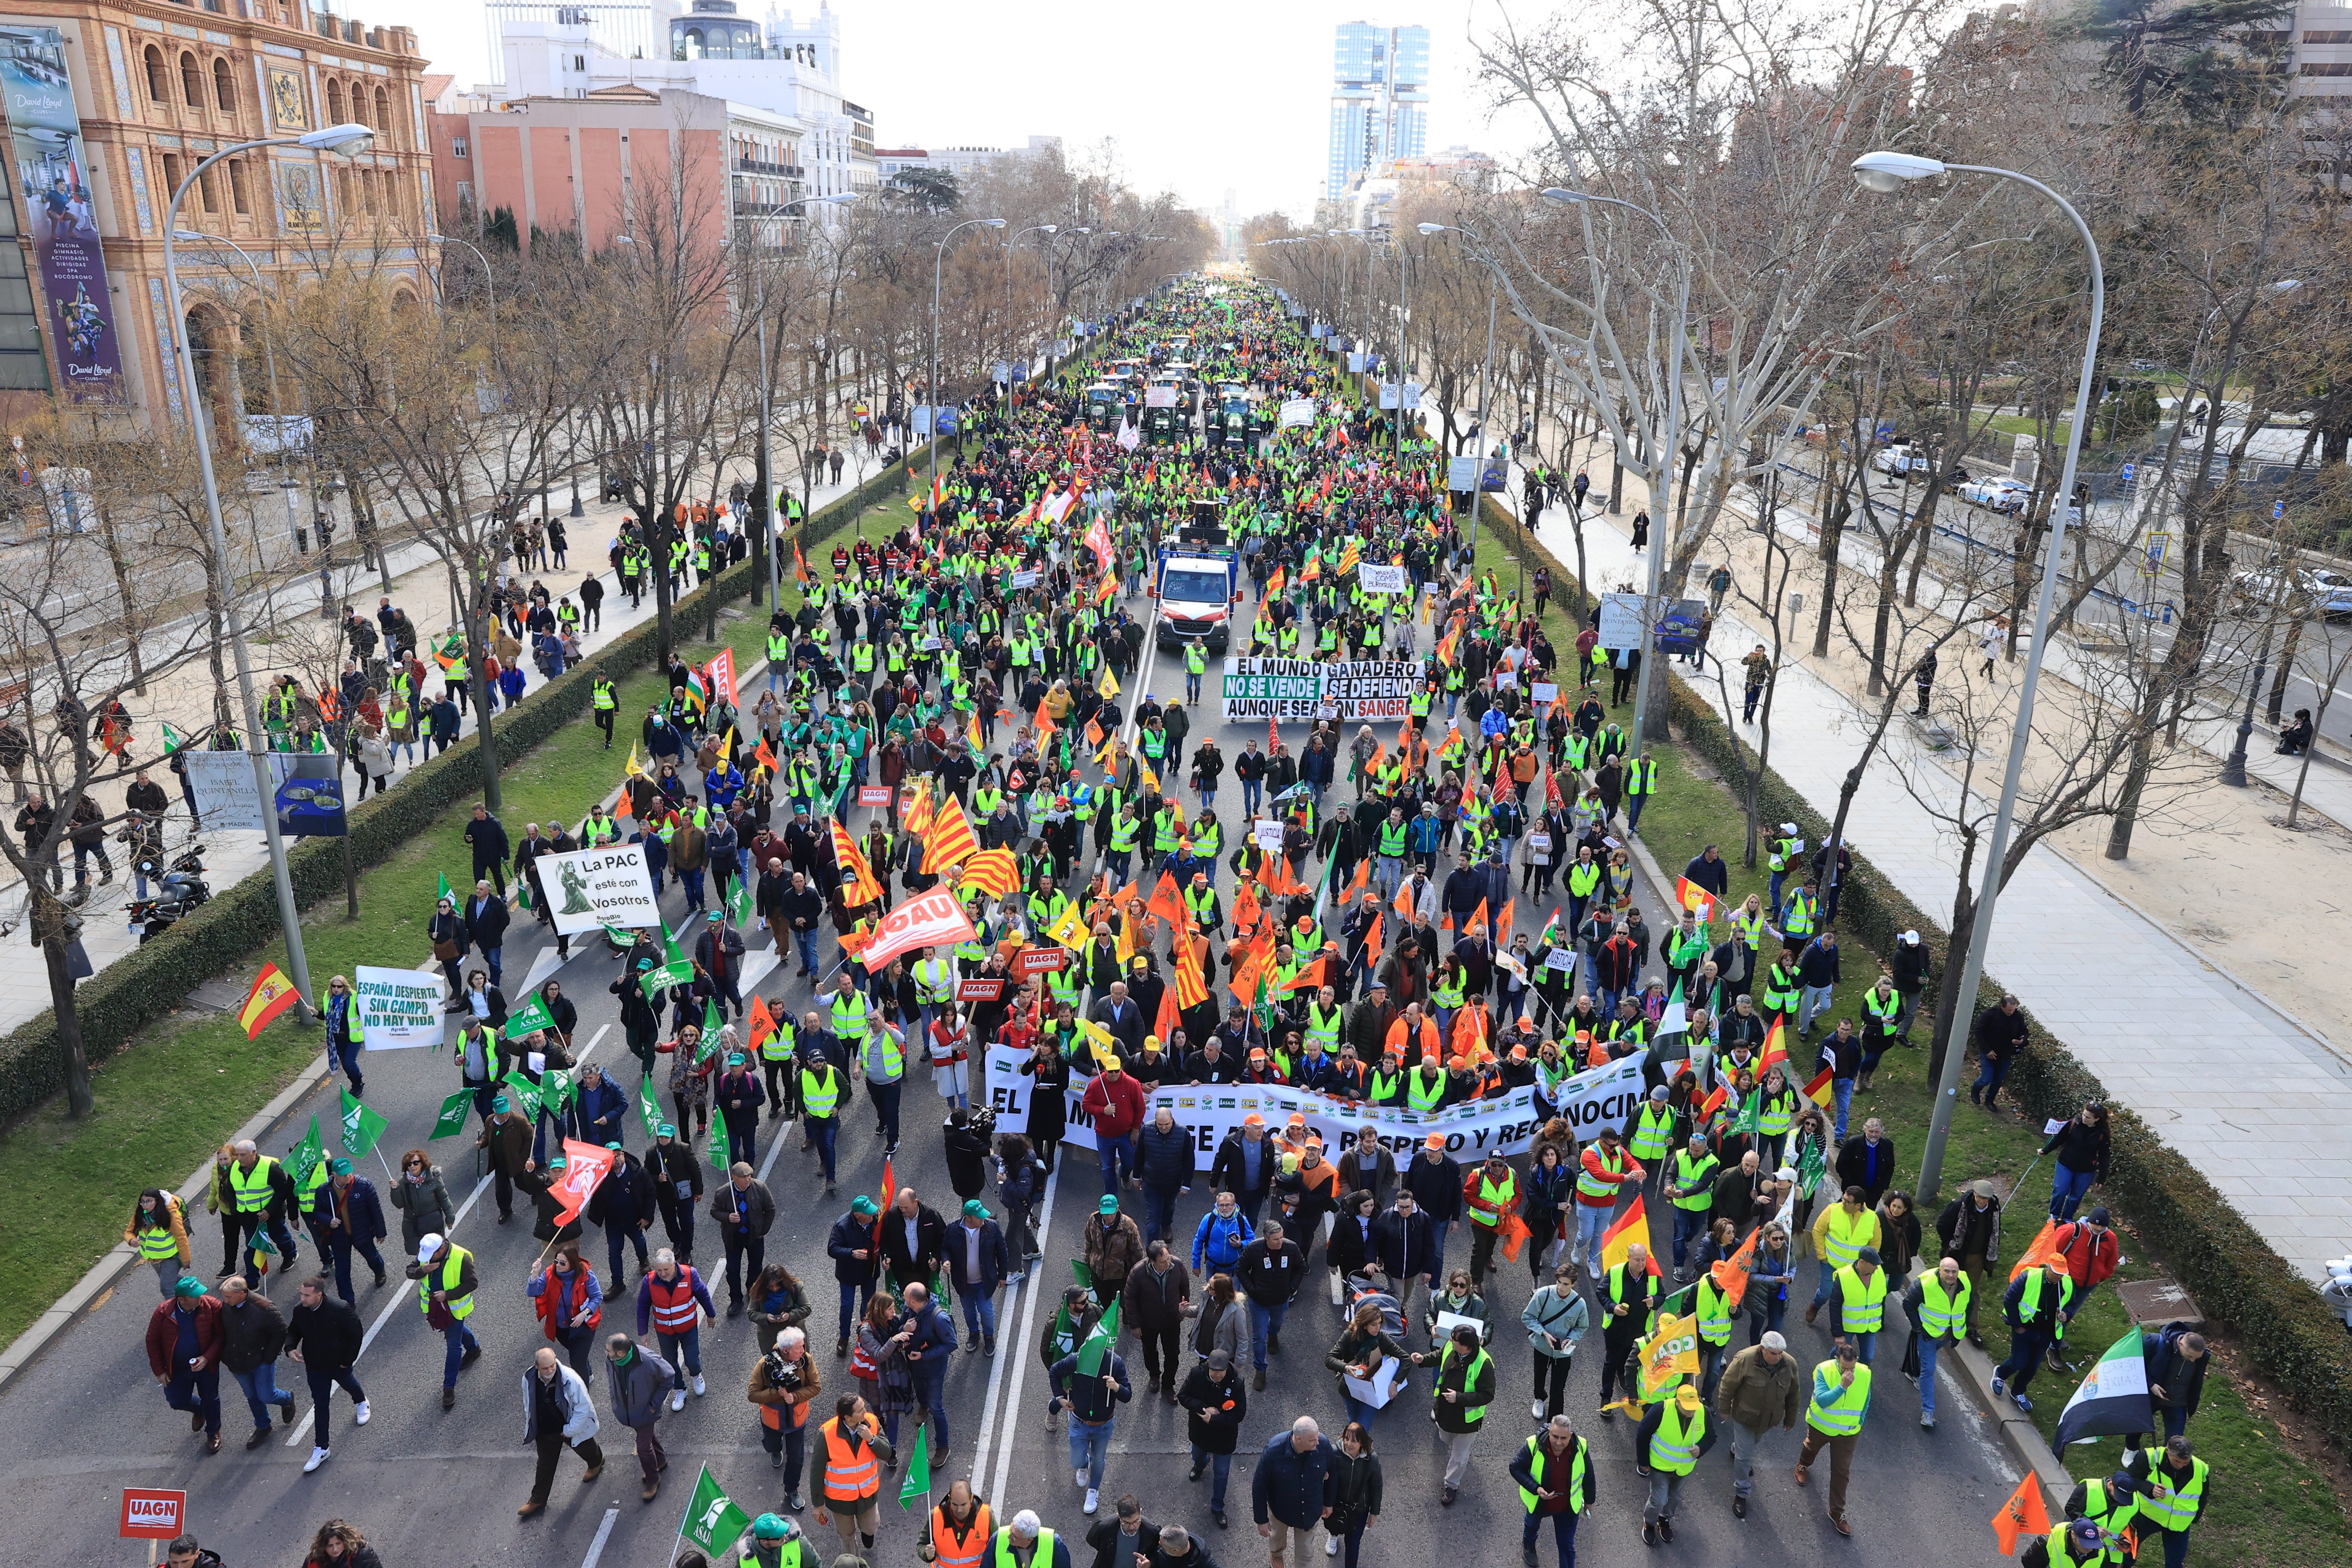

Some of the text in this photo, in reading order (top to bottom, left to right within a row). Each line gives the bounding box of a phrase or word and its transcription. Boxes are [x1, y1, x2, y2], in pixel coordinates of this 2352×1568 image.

[15, 94, 62, 109] David Lloyd
[68, 363, 112, 377] David Lloyd
[1238, 658, 1416, 678] EL MUNDO GANADERO
[1226, 677, 1245, 696] NO
[1249, 677, 1268, 697] SE
[1329, 678, 1349, 697] SE
[1228, 700, 1288, 717] AUNQUE
[1337, 701, 1354, 717] ON
[582, 854, 638, 873] La PAC
[595, 878, 638, 890] esté con
[591, 895, 649, 909] Vosotros
[1026, 955, 1058, 963] UAGN
[1548, 951, 1575, 968] ¡JUSTICIA!
[358, 981, 440, 1000] ESPAÑA DESPIERTA,
[369, 998, 428, 1015] SIN CAMPO
[364, 1014, 435, 1027] NO HAY VIDA
[519, 1015, 547, 1028] ASAJA
[993, 1087, 1022, 1114] EL
[453, 1099, 466, 1124] ASAJA
[342, 1127, 356, 1142] AJA
[1339, 1131, 1465, 1155] RSPEO
[1474, 1130, 1489, 1149] Y
[131, 1501, 175, 1516] UAGN
